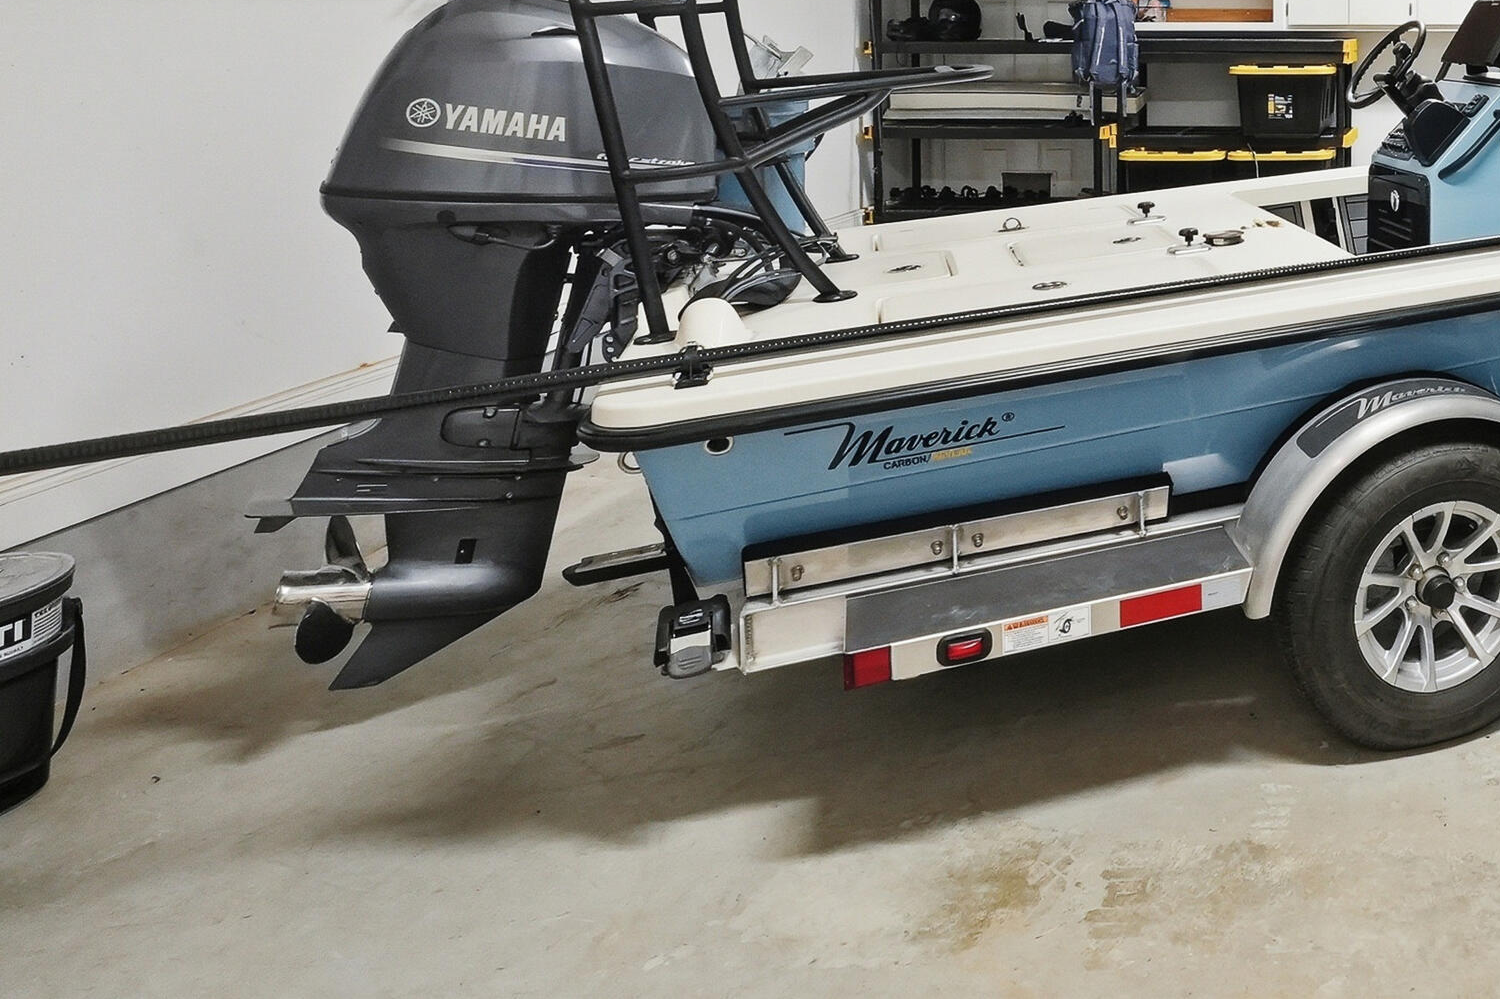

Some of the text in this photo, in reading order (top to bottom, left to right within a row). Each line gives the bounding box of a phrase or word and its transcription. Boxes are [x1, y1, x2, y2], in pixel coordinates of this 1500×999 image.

[444, 103, 567, 143] YAMAHA
[1357, 385, 1466, 420] Maverick
[828, 416, 1001, 470] Maverick
